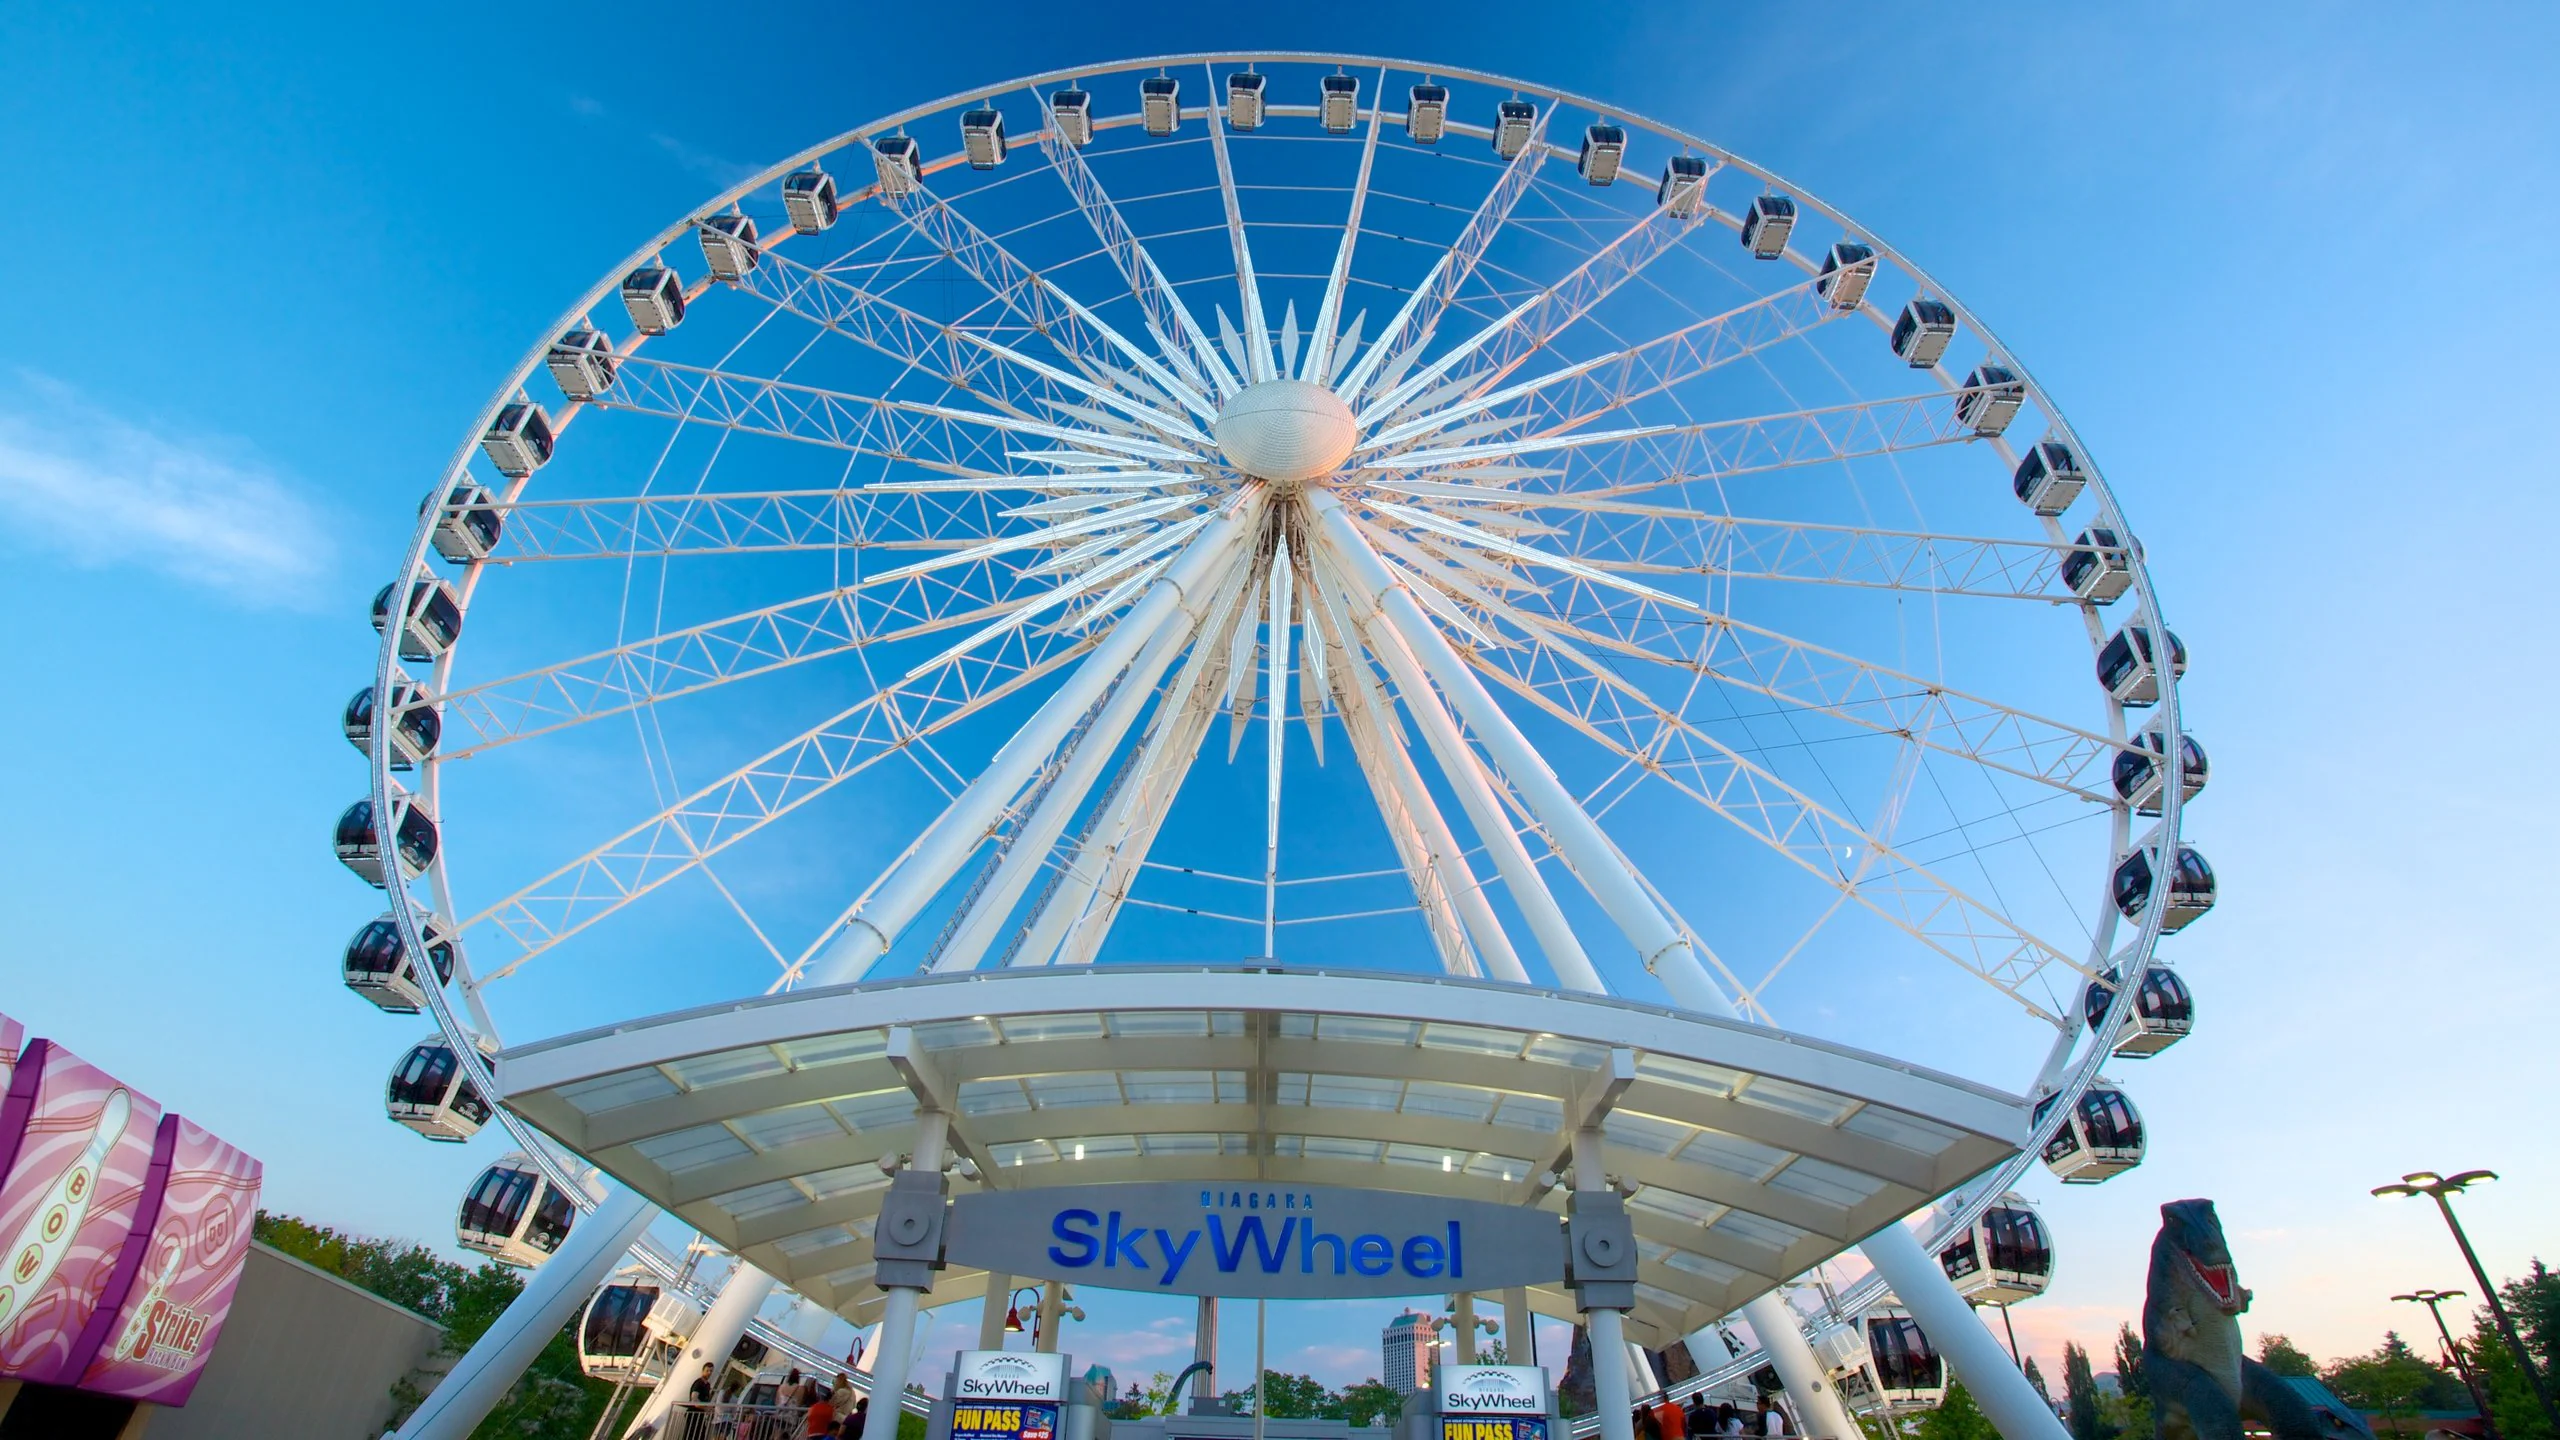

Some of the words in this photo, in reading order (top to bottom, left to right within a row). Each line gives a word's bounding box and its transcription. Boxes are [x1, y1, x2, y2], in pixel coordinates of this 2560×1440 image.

[1200, 1191, 1313, 1210] NIAGARA
[1047, 1208, 1462, 1286] SkyWheel
[132, 1299, 210, 1360] Strike!
[963, 1378, 1050, 1396] SkyWheel
[1448, 1393, 1536, 1411] SkyWheel
[953, 1409, 982, 1430] FUN
[982, 1410, 1021, 1432] PASS
[1444, 1423, 1474, 1440] FUN
[1475, 1424, 1514, 1440] PASS
